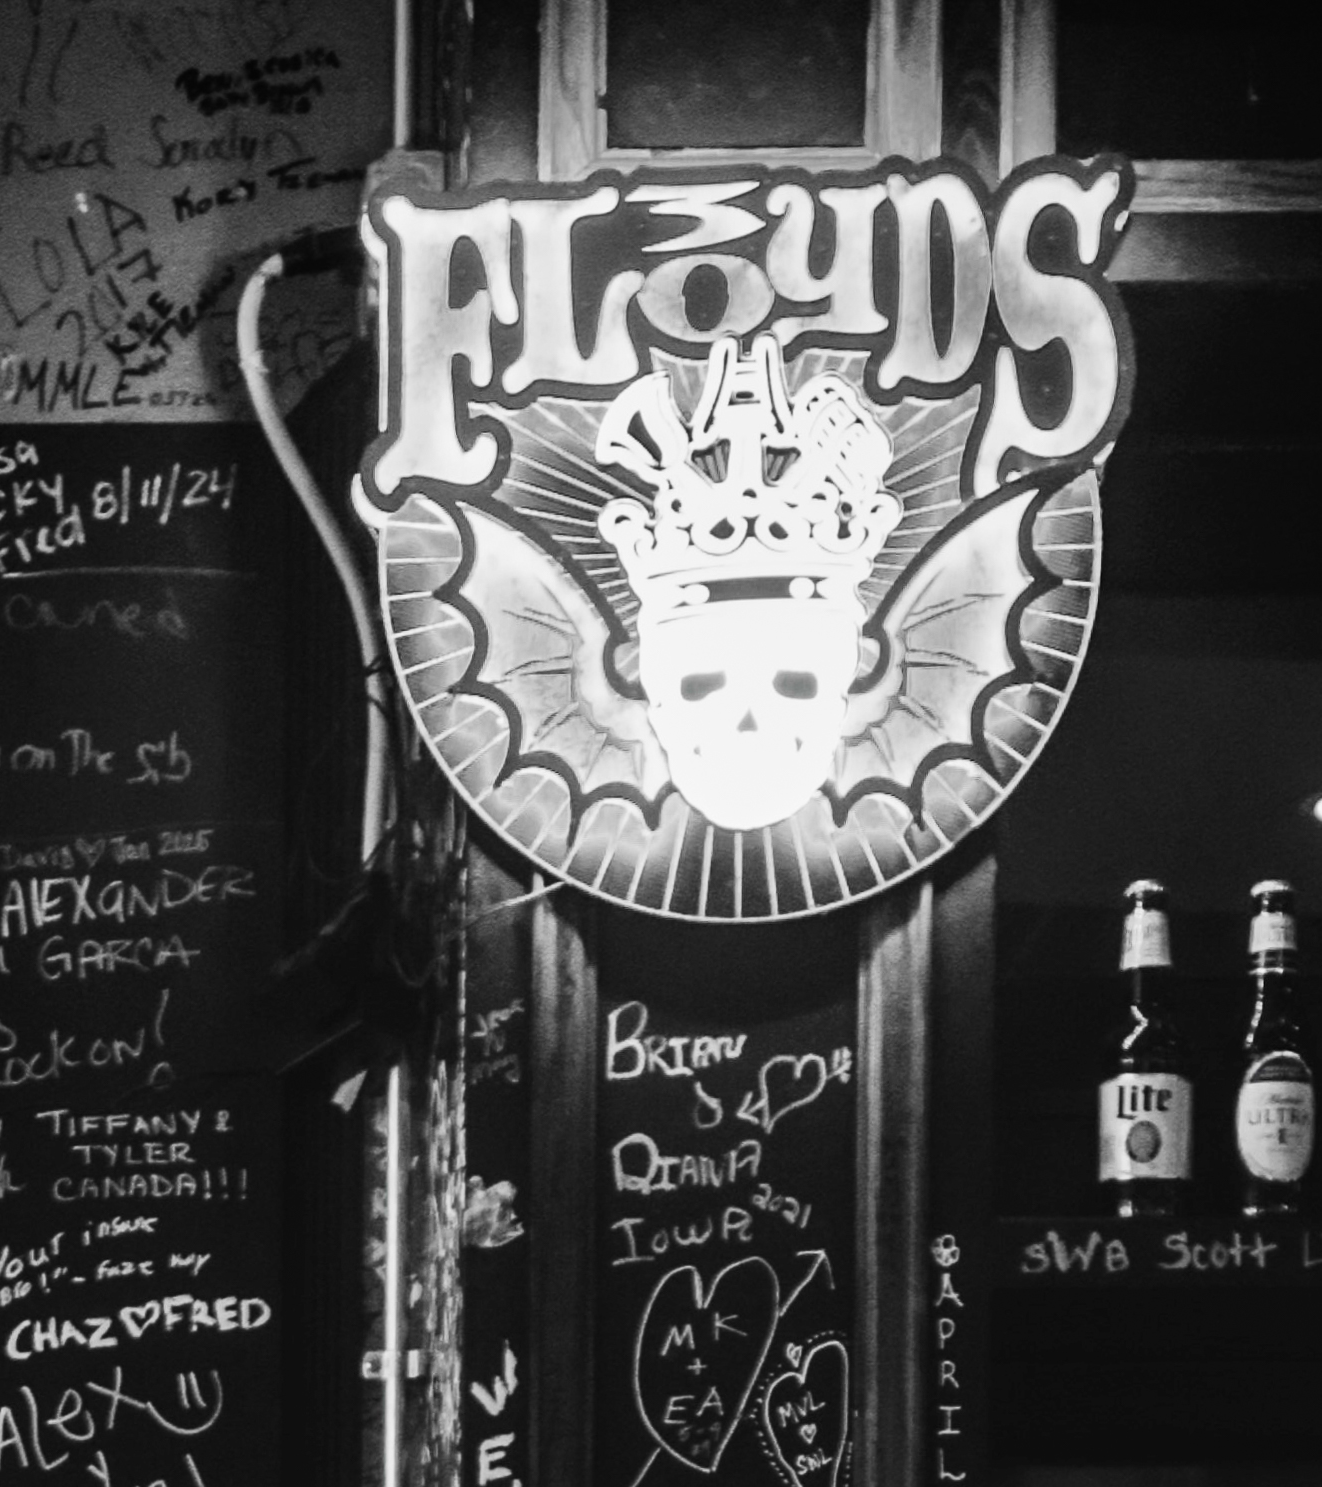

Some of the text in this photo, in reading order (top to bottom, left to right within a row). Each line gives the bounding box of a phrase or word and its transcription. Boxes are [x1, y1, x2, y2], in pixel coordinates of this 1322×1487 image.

[93, 464, 237, 526] 8/11/24
[1116, 1085, 1173, 1120] Lite
[36, 1109, 202, 1138] TIFFANY
[72, 1143, 196, 1166] TYLER
[1156, 1232, 1277, 1271] Scott
[6, 1295, 272, 1361] CHAZ FRED
[934, 1272, 967, 1483] APRIL
